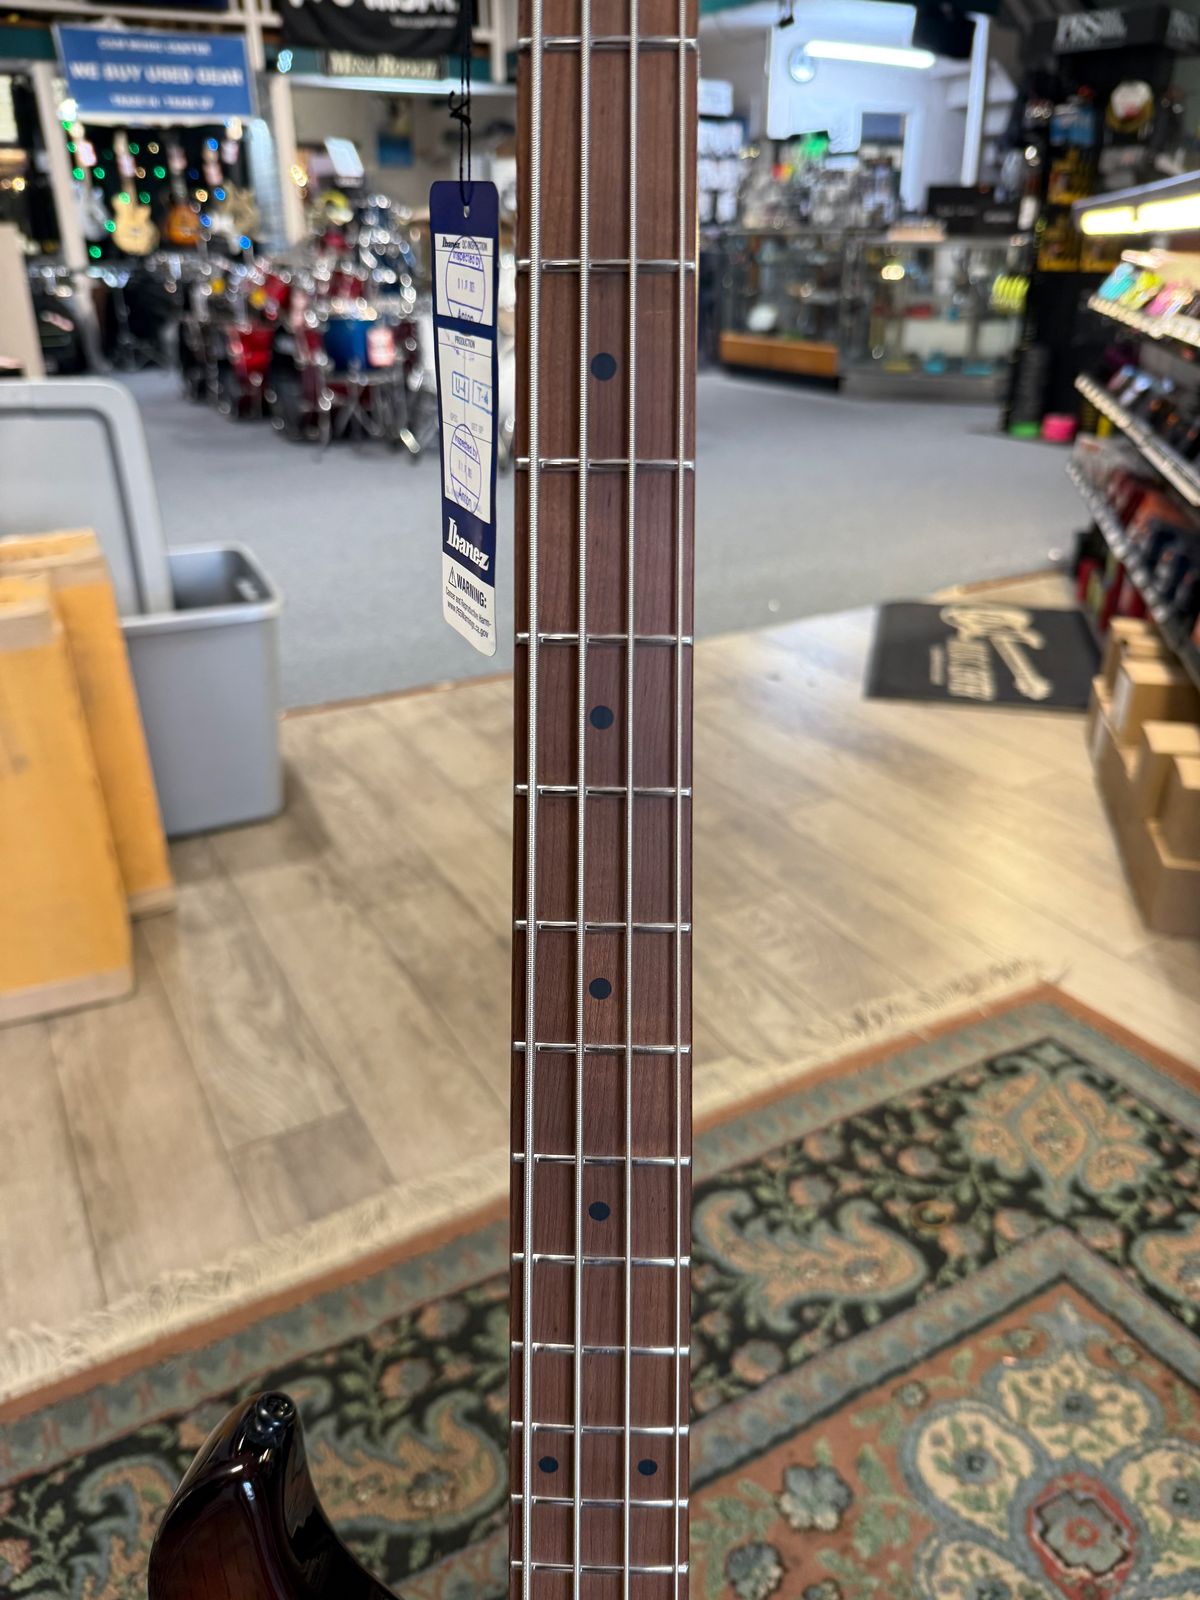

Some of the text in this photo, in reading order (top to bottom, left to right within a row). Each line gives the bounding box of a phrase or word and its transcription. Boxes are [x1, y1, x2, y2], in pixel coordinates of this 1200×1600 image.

[69, 62, 243, 87] WE BUY USED GEAR
[442, 236, 460, 248] Ibanez
[455, 335, 475, 349] PRODUCTION
[446, 516, 489, 571] Ibanez
[456, 573, 487, 608] WARNING:
